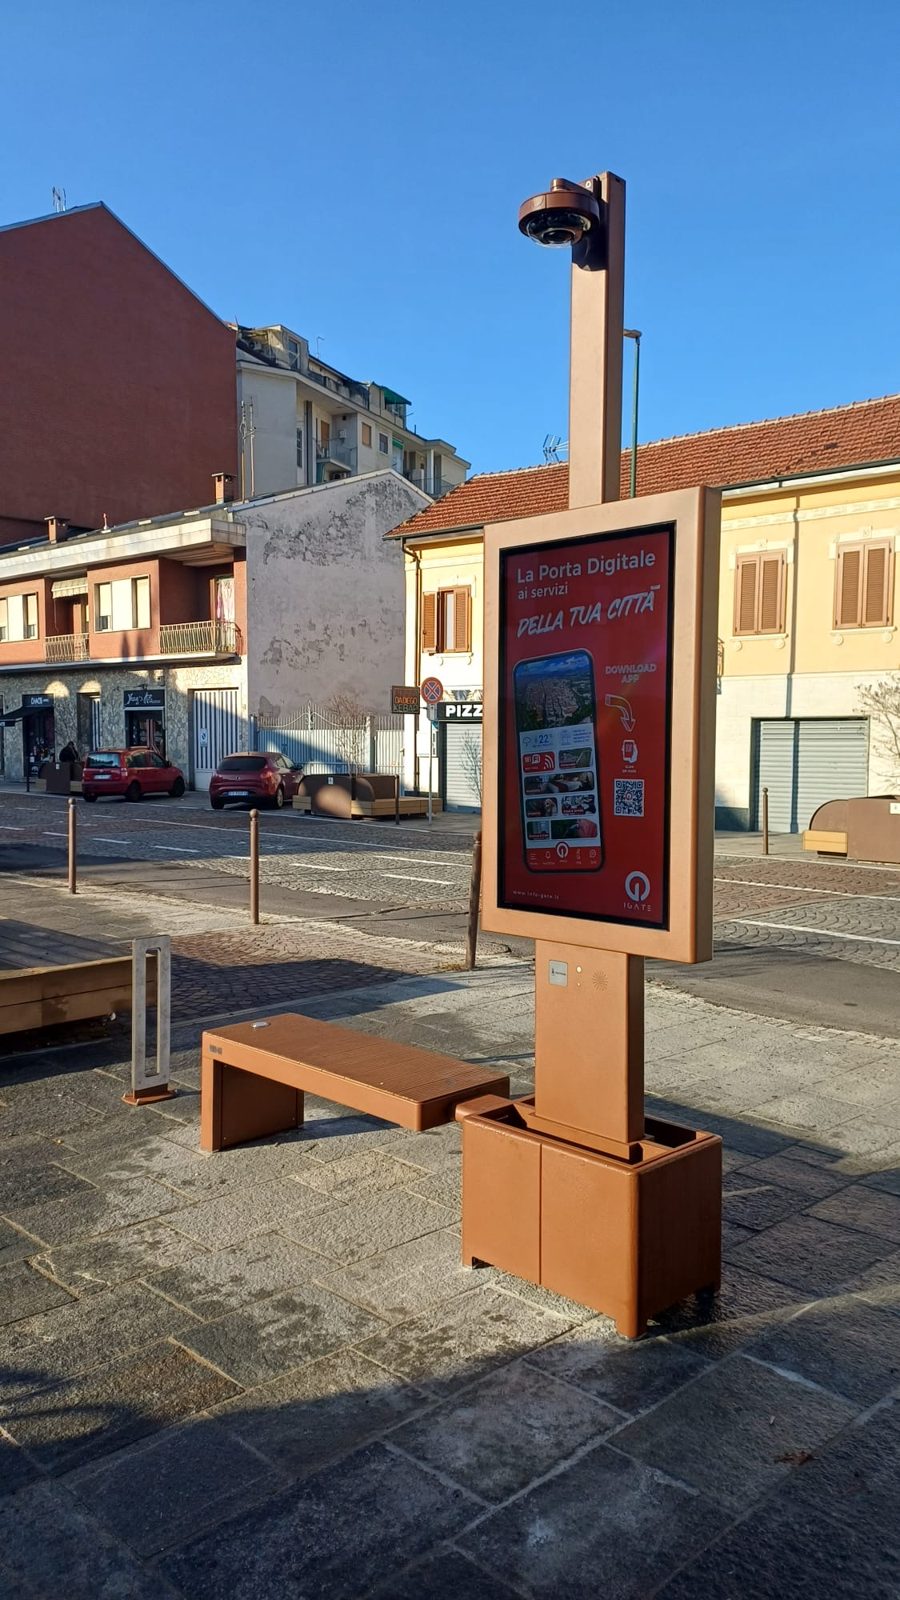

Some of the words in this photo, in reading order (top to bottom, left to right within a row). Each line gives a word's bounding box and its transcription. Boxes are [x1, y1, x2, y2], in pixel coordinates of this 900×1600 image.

[517, 568, 534, 583] La
[539, 562, 582, 581] Porta
[587, 550, 656, 576] Digitale
[518, 587, 528, 600] ai
[530, 581, 569, 598] servizi
[516, 610, 564, 638] DELLA
[569, 602, 602, 627] TUA
[605, 663, 657, 674] DOWNLOAD
[621, 674, 640, 684] APP
